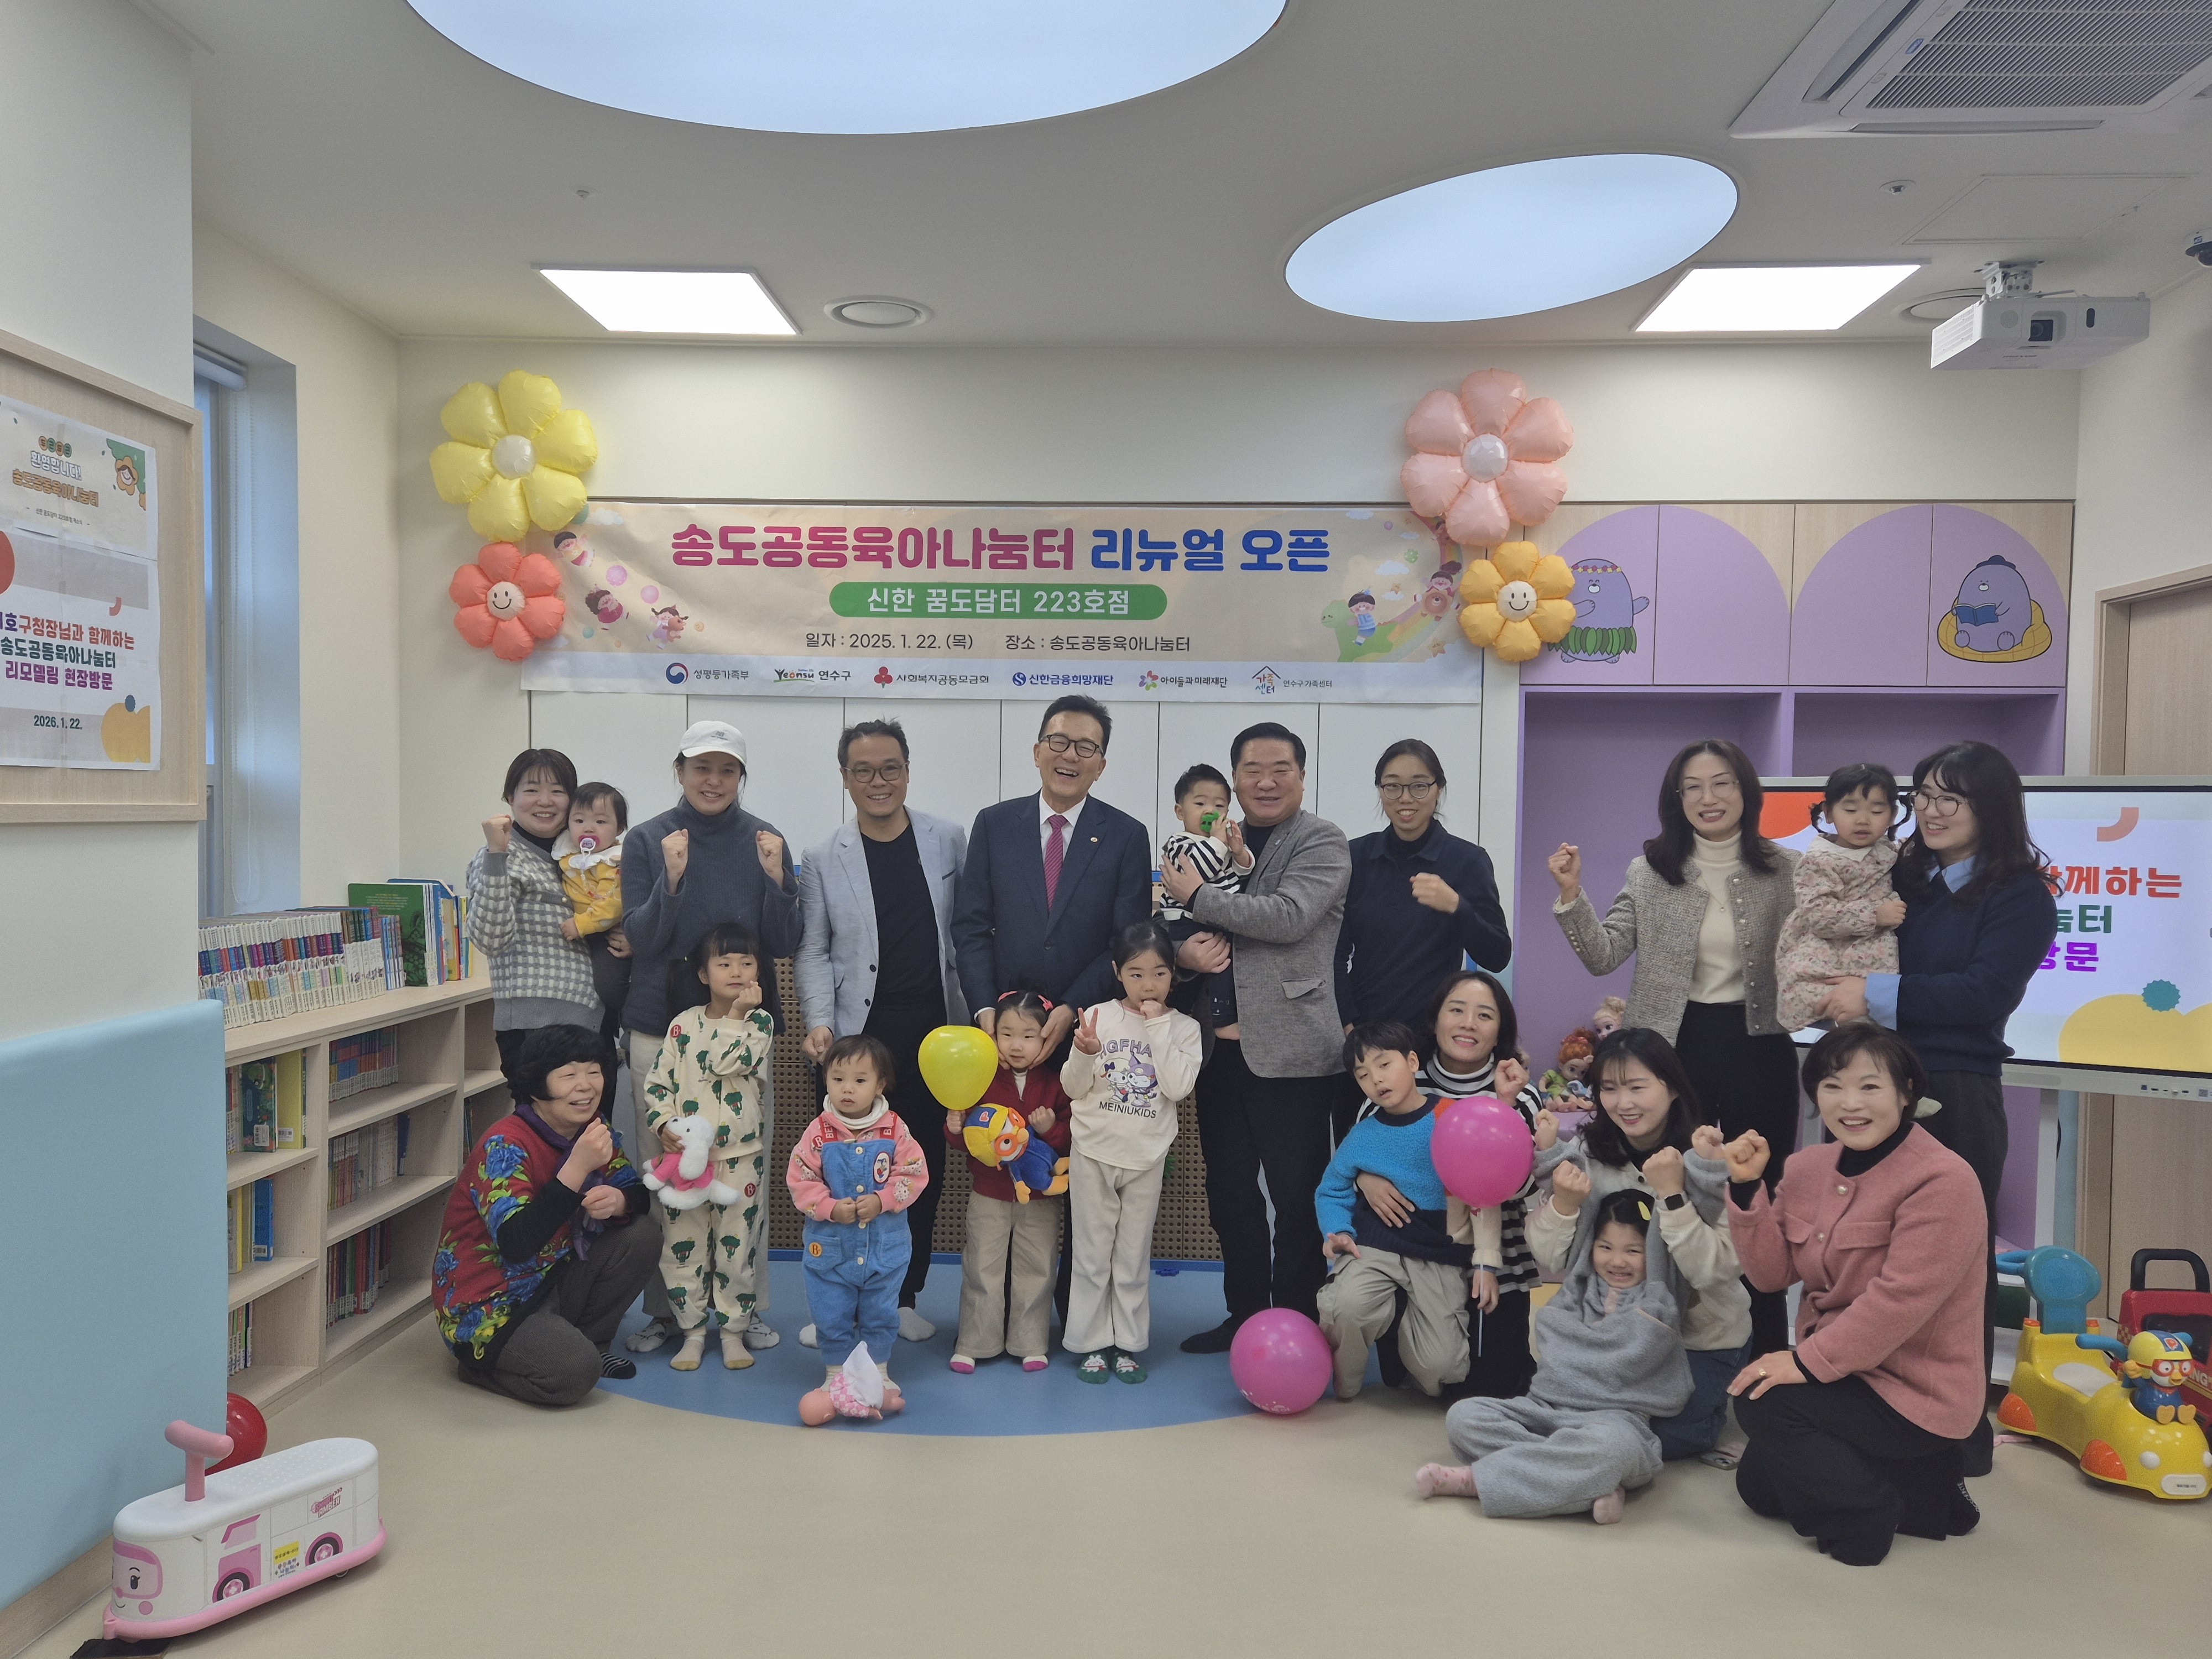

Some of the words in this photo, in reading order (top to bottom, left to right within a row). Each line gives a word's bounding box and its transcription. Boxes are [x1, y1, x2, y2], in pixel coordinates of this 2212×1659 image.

[30, 451, 82, 481] 환영합니다!
[12, 468, 99, 508] 송도공동육아나눔터
[671, 523, 1074, 570] 송도공동육아나눔터
[1091, 528, 1224, 572] 리뉴얼
[1240, 529, 1330, 572] 오픈
[867, 587, 915, 613] 신한
[926, 588, 1020, 614] 꿈도담터
[1034, 589, 1129, 615] 223호점
[88, 626, 135, 650] 함께하는
[806, 633, 836, 648] 일자
[849, 634, 896, 649] 2025.
[946, 634, 973, 650] (목)
[1005, 635, 1036, 650] 장소
[1050, 635, 1190, 651] 송도공동육아나눔터
[1, 637, 116, 668] 송도공동육아나눔터
[6, 660, 59, 685] 리모델링
[65, 668, 113, 690] 현장방문
[693, 669, 749, 680] 성평등가족부
[774, 668, 815, 681] Yeonsu
[818, 670, 852, 681] 연수구
[896, 674, 989, 686] 사회복지공동모금회
[1029, 674, 1114, 686] 신한금융희망재단
[1256, 673, 1275, 687] 가족
[1255, 685, 1275, 695] 센터
[1305, 680, 1333, 688] 가족센터
[1099, 1101, 1157, 1119] MEINIUKIDS
[318, 1495, 341, 1518] AMBER
